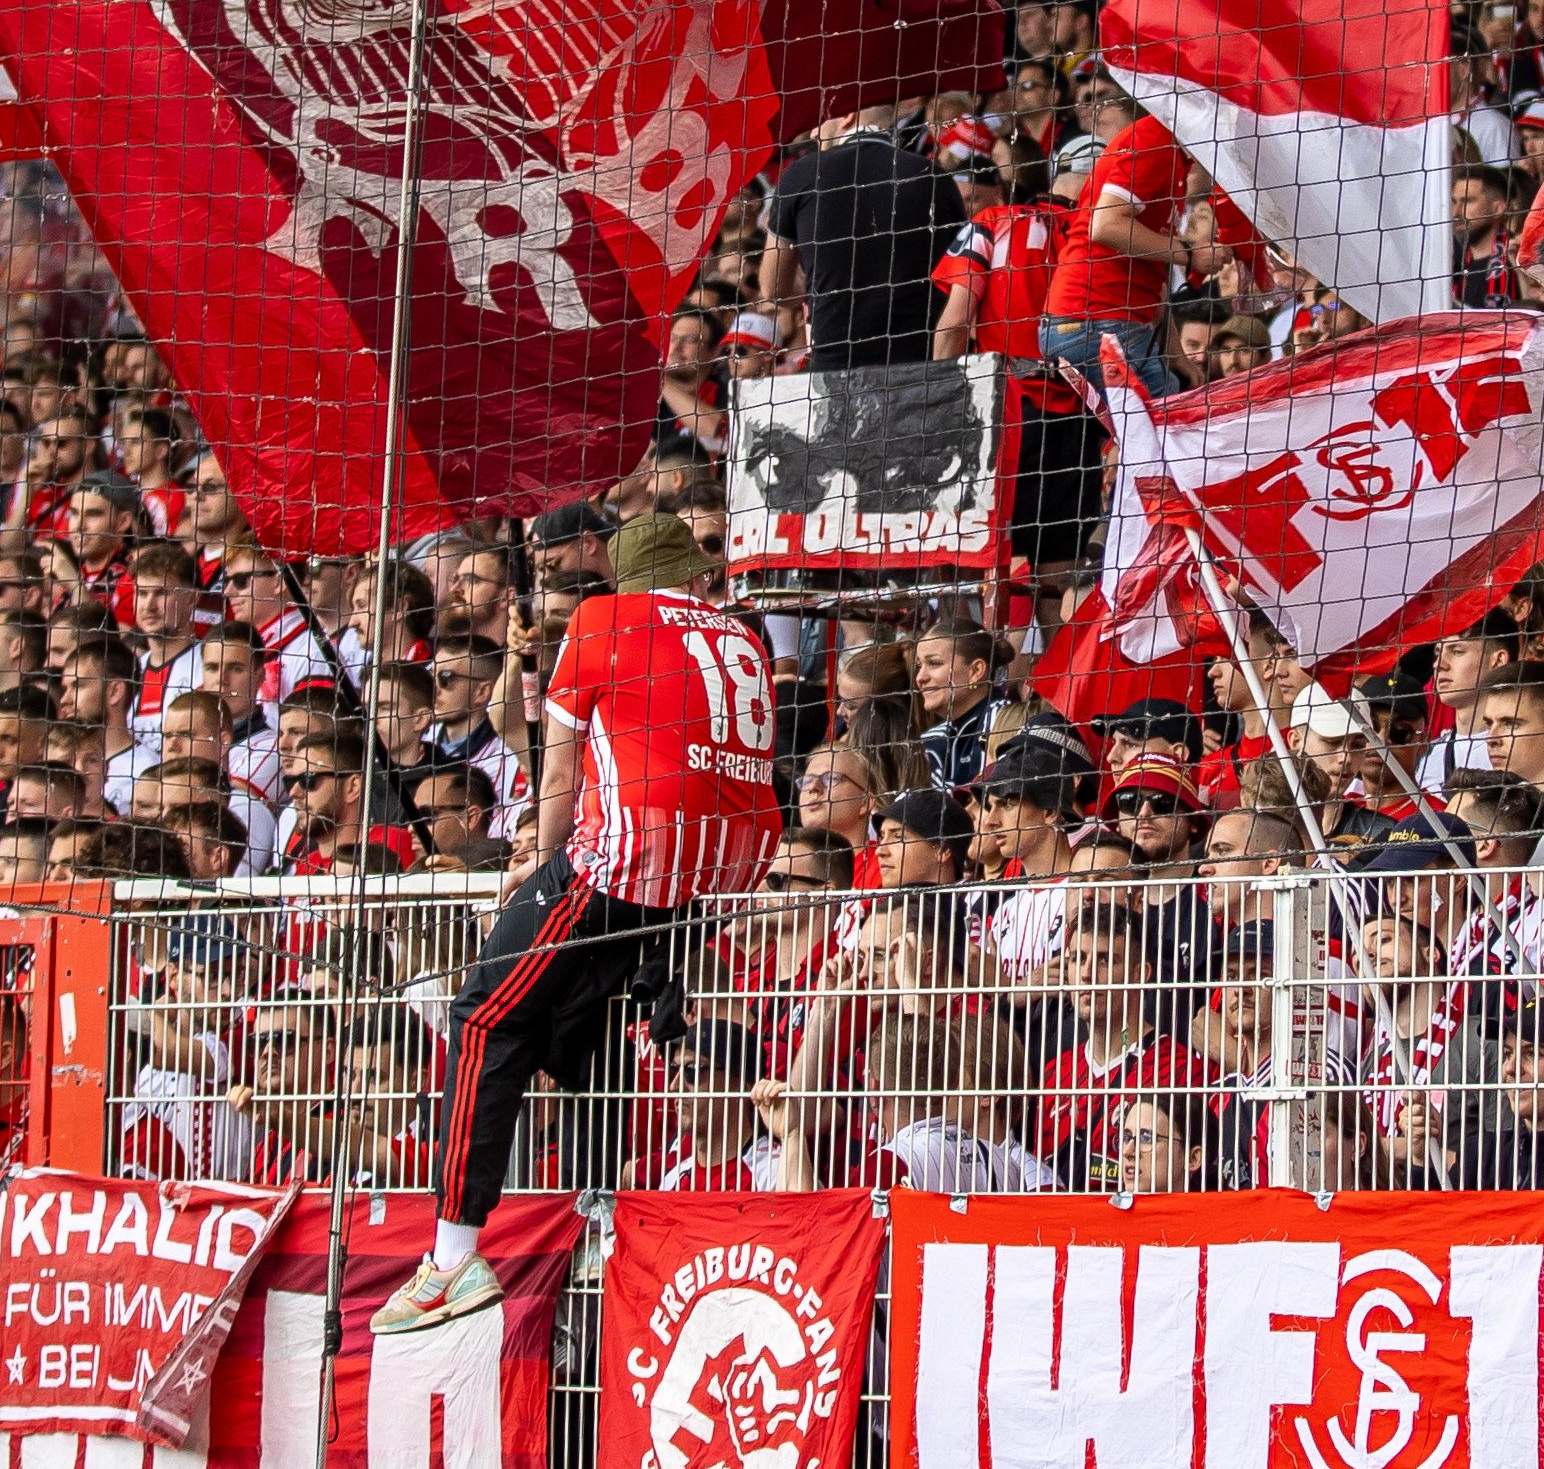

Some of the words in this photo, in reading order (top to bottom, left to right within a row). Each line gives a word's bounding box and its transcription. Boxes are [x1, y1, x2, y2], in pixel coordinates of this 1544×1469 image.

[659, 604, 750, 637] PETERSEN
[682, 630, 773, 752] 18
[687, 743, 713, 771] SC
[5, 1267, 91, 1329] FÜR
[104, 1281, 214, 1336] IMME
[38, 1343, 98, 1391] BEI
